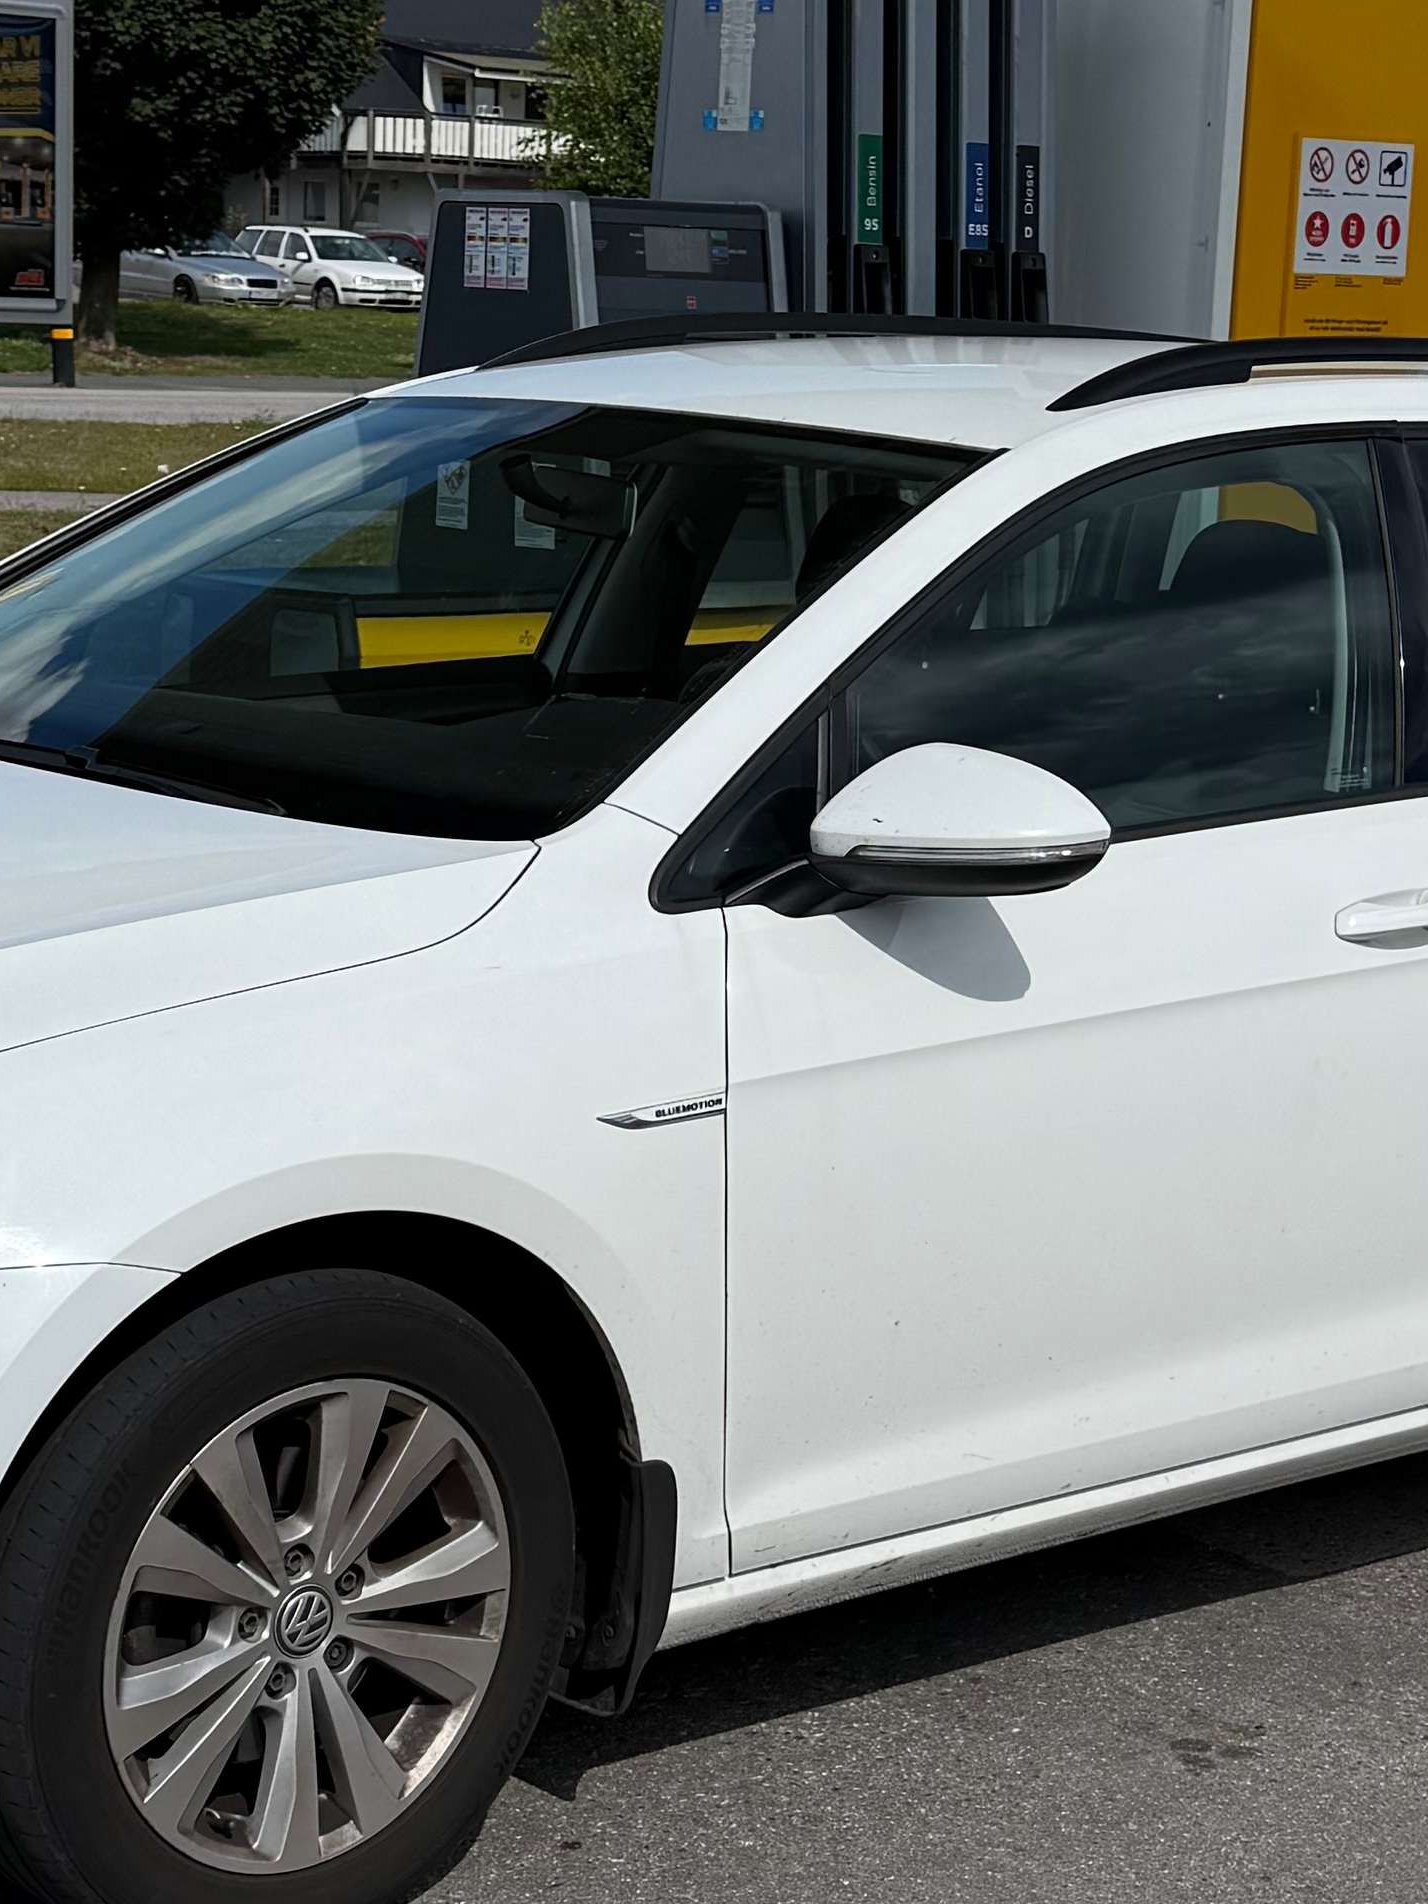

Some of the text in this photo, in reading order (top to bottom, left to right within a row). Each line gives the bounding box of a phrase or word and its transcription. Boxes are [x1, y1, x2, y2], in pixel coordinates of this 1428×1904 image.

[866, 155, 877, 207] Bensin
[974, 162, 984, 213] Etanol
[1024, 165, 1034, 215] Diesel
[864, 218, 879, 231] 95
[968, 224, 989, 236] E85
[1024, 226, 1033, 239] D
